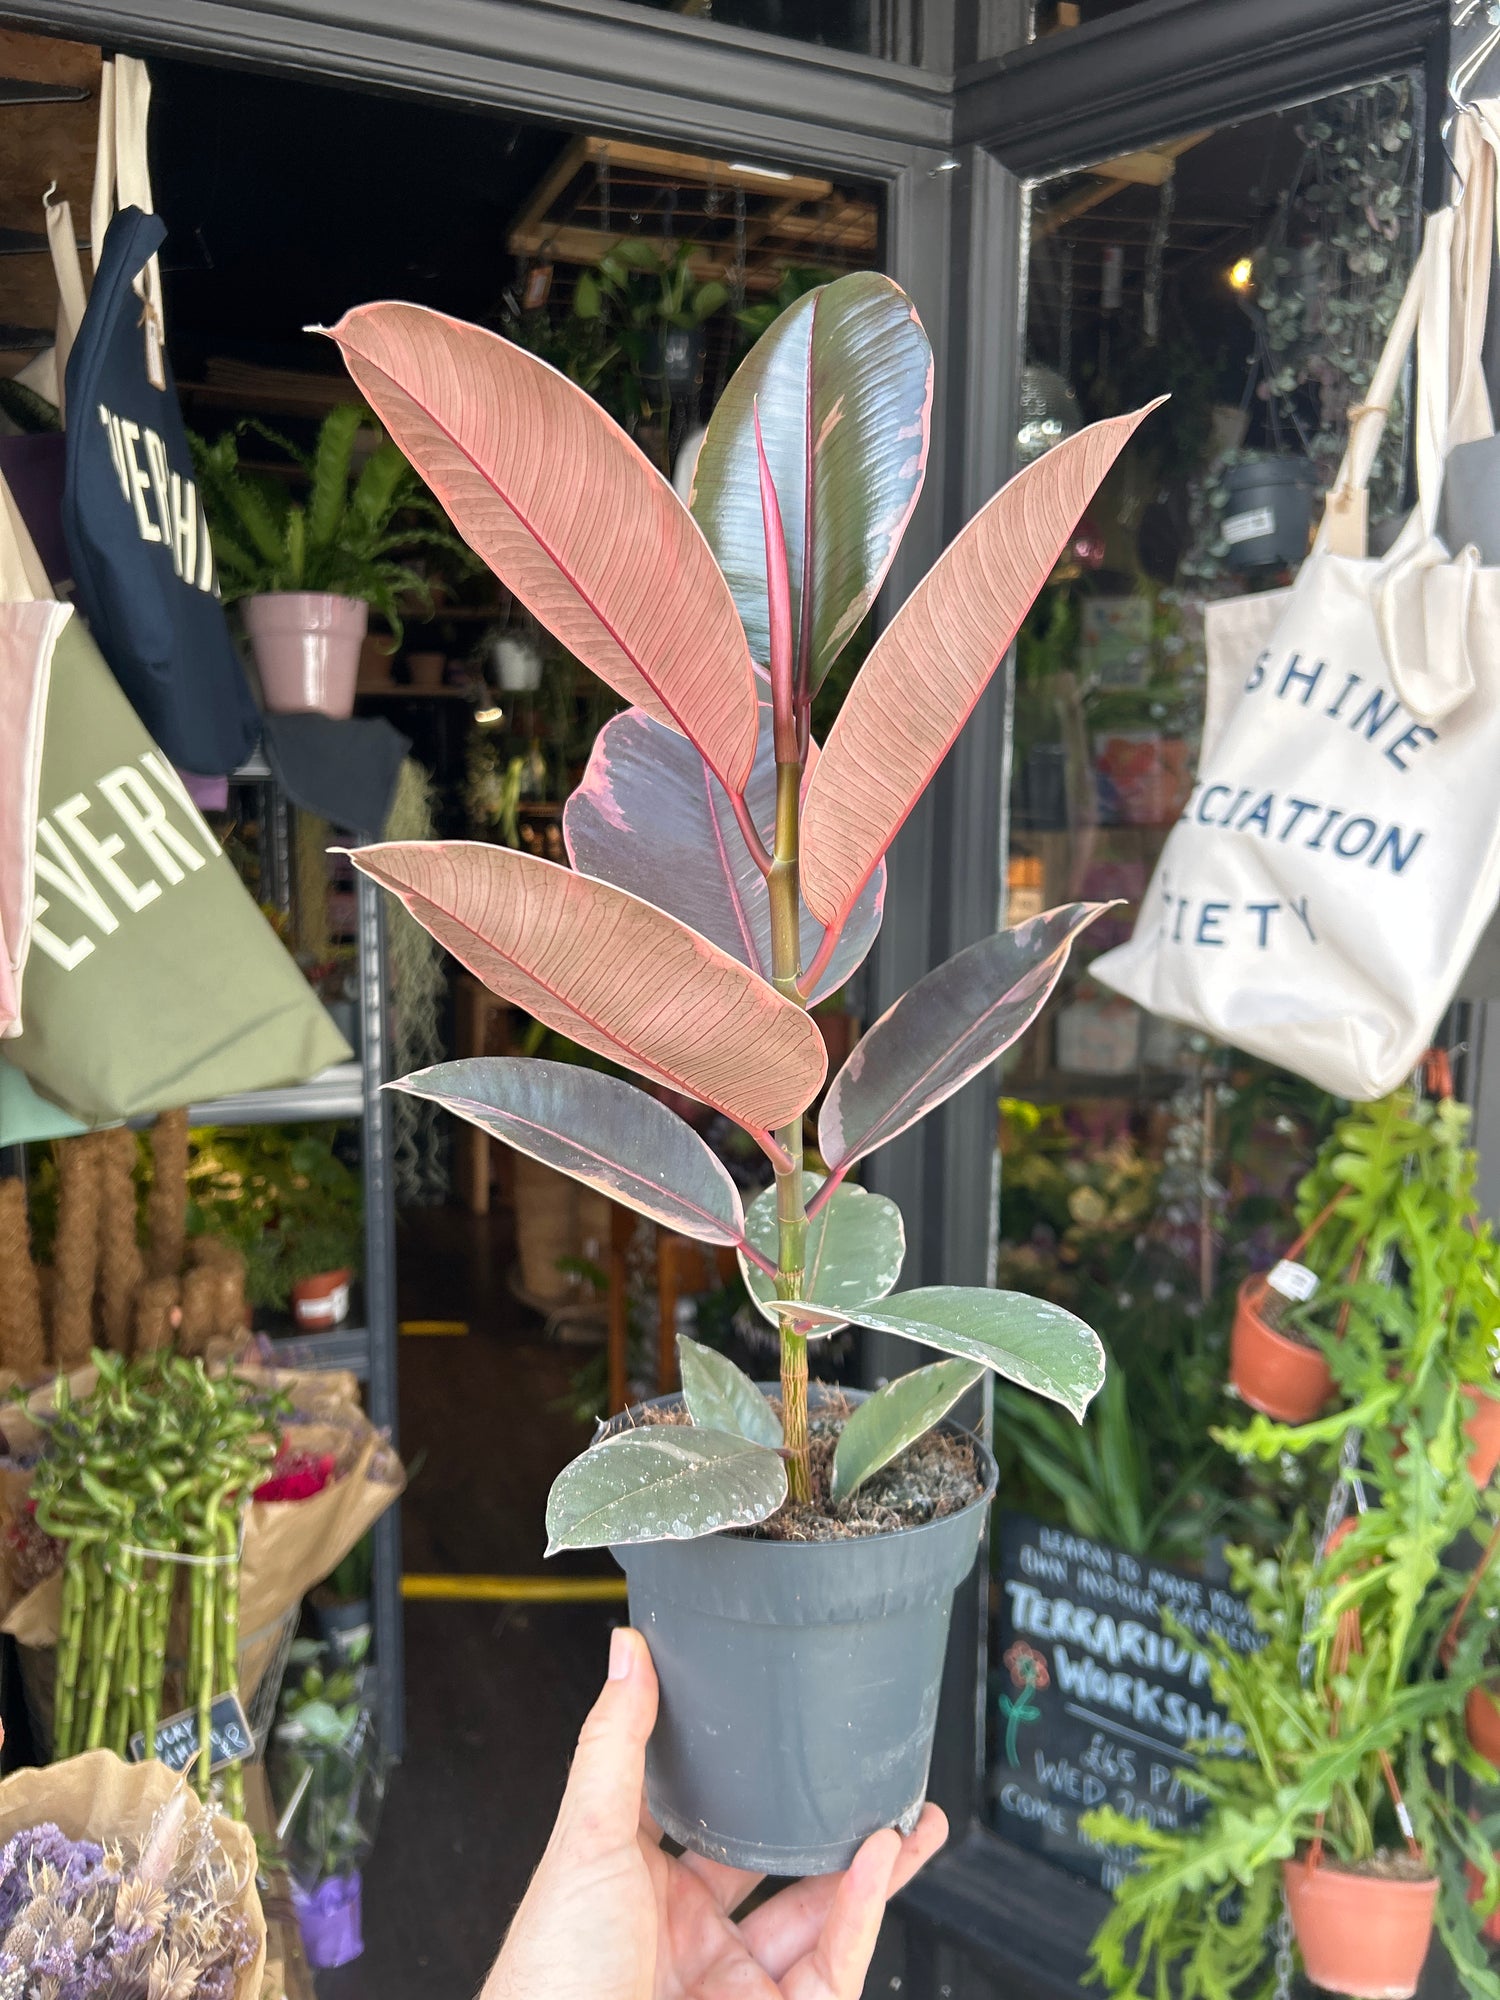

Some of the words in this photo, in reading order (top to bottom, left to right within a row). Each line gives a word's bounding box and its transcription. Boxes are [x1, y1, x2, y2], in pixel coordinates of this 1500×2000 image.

[1244, 647, 1439, 771] SHINE
[1182, 784, 1425, 877] CIATION
[1161, 894, 1316, 948] IETY
[1019, 1543, 1068, 1584] OWN
[1039, 1526, 1112, 1573] LEARN
[1117, 1553, 1142, 1583] TO
[1149, 1568, 1202, 1606] MAKE
[1052, 1643, 1249, 1757] WORKSHO
[141, 1718, 195, 1752] UCKY
[1034, 1749, 1107, 1806] WED
